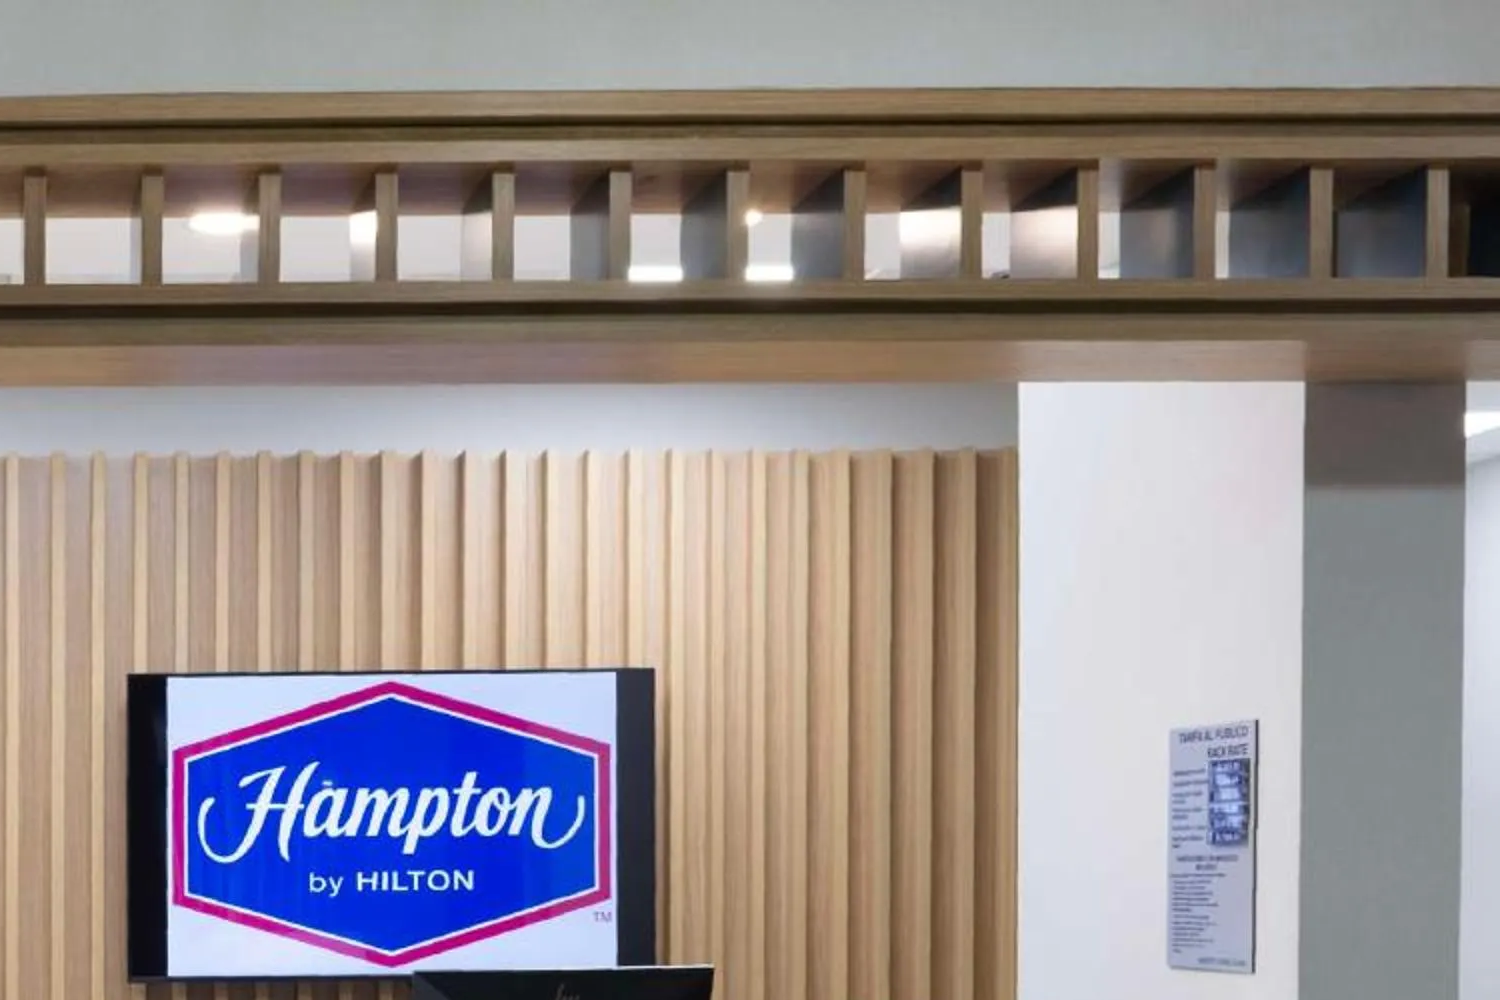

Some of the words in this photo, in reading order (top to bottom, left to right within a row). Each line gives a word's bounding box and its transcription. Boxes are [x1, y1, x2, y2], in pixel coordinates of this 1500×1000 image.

[198, 761, 585, 863] Hampton
[309, 872, 343, 897] by
[356, 869, 474, 892] HILTON
